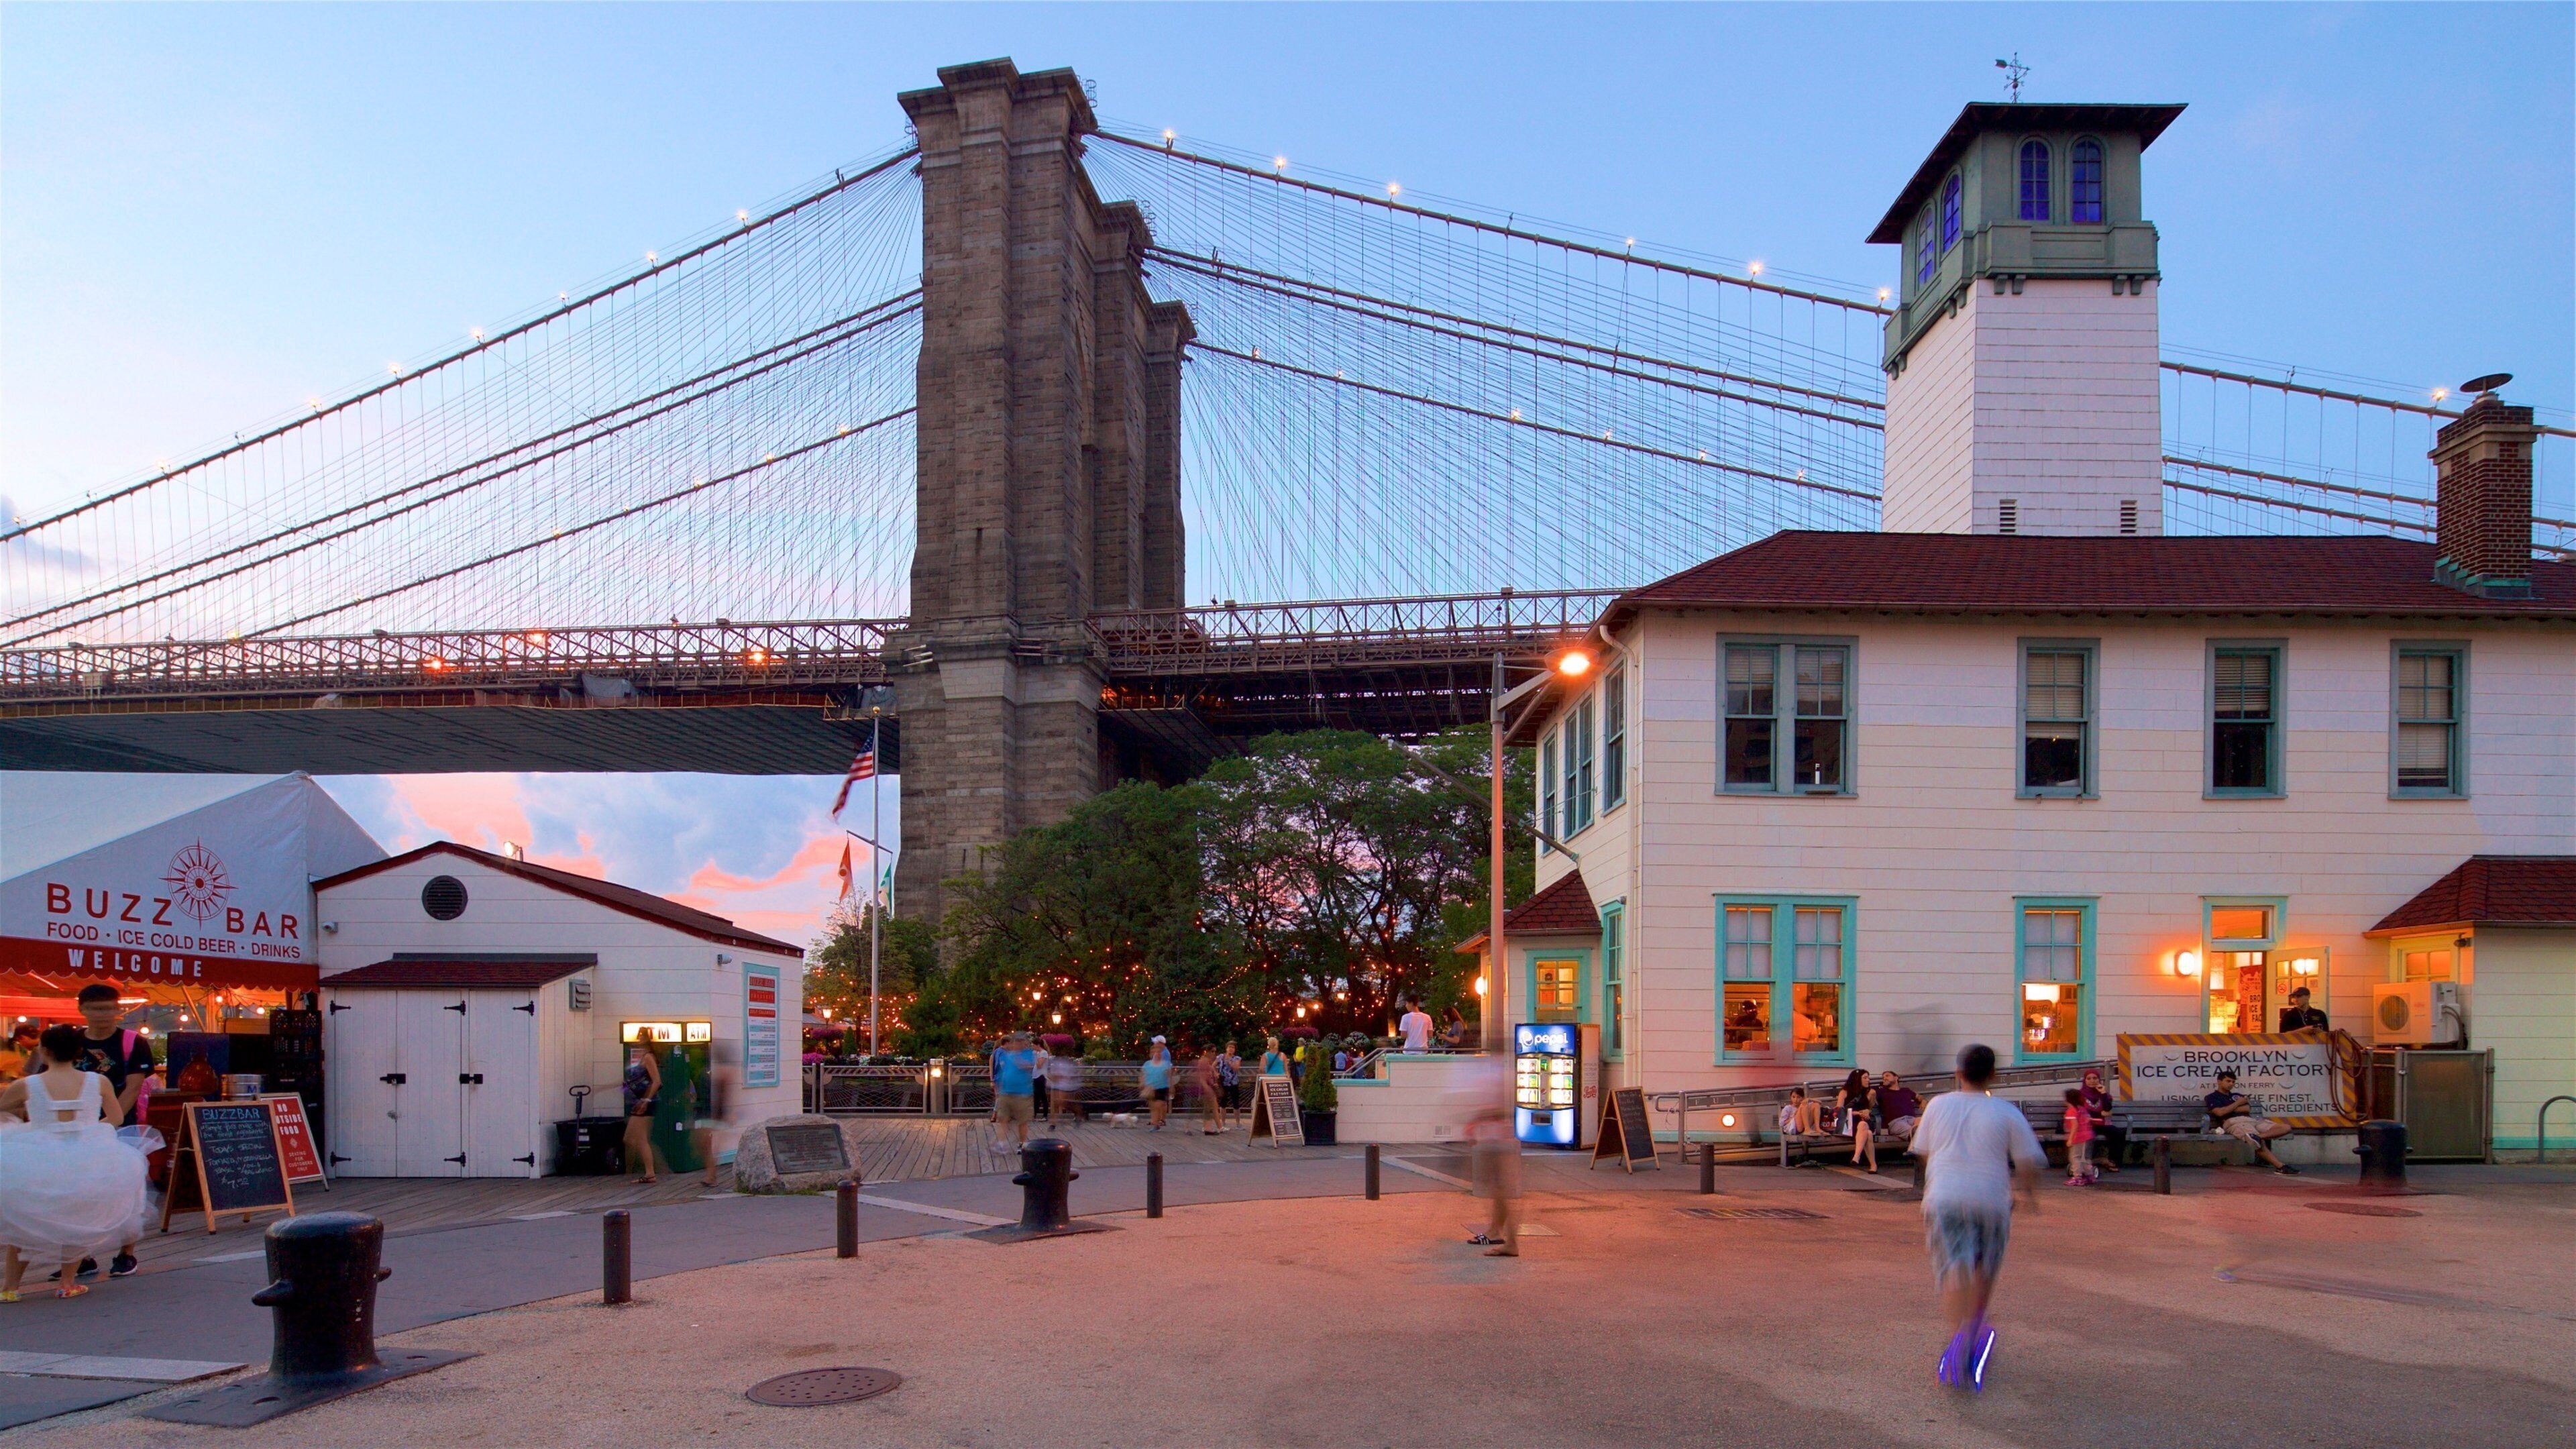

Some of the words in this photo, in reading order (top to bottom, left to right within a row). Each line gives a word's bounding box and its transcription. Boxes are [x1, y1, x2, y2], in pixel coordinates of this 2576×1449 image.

[47, 883, 172, 926] BUZZ
[225, 907, 299, 939] BAR
[48, 922, 99, 941] FOOD
[117, 929, 145, 946] ICE
[150, 933, 194, 949] COLD
[199, 938, 236, 953] BEER
[252, 943, 301, 959] DRINKS
[68, 948, 202, 977] WELCOME
[690, 1026, 707, 1040] ATM
[2184, 1051, 2288, 1063] BROOKLYN
[2137, 1065, 2167, 1077] ICE
[2173, 1065, 2241, 1077] CREAM
[2249, 1064, 2333, 1077] FACTORY
[276, 1103, 288, 1112] NO
[2261, 1104, 2339, 1112] NGREDIENTS
[202, 1108, 260, 1120] BUZZBAR
[275, 1114, 302, 1124] UTSIDE
[279, 1125, 299, 1135] FOOD
